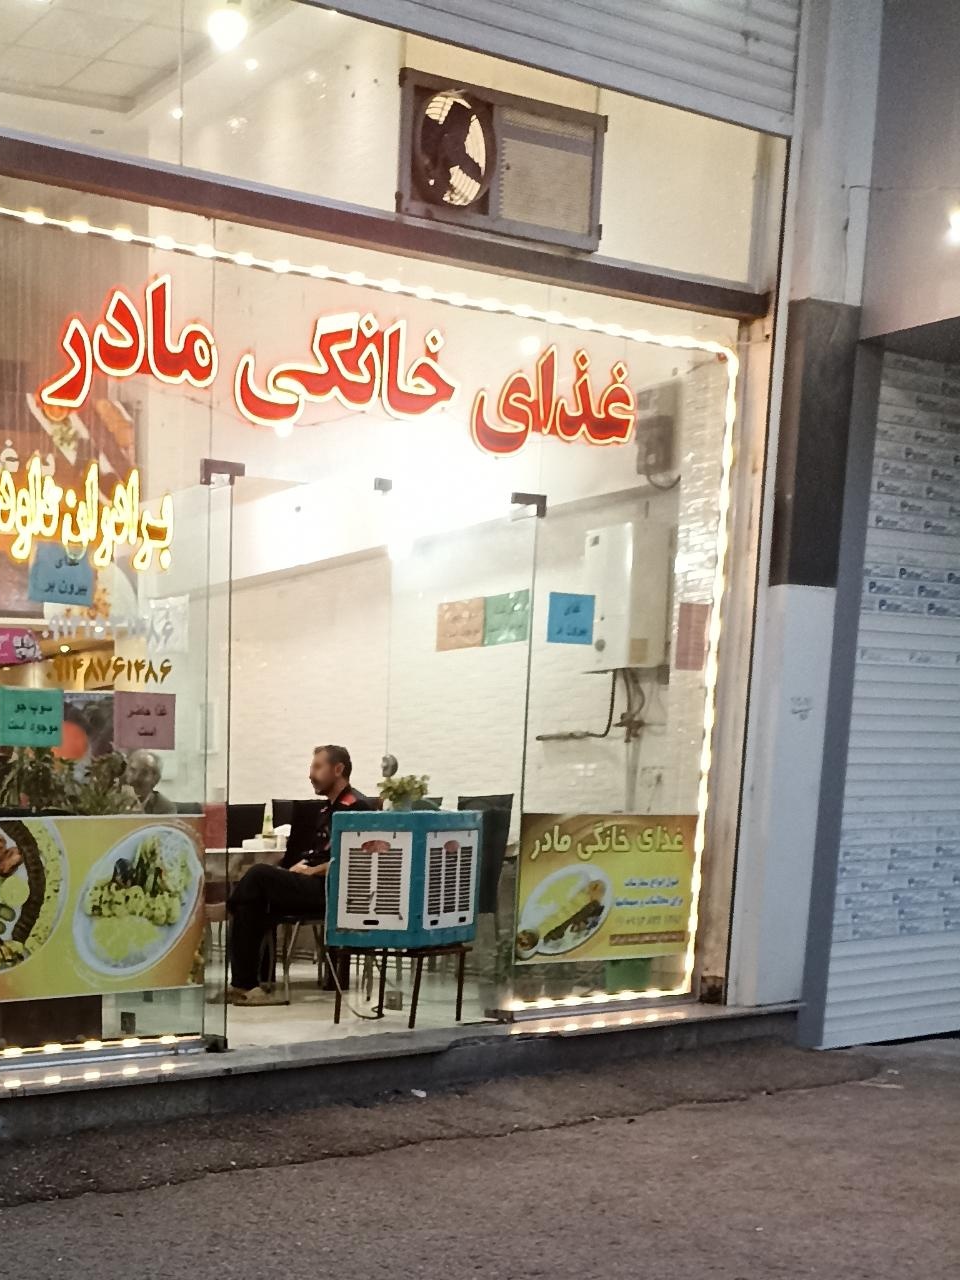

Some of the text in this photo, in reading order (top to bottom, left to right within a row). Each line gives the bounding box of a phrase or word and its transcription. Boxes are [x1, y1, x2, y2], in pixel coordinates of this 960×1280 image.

[41, 275, 219, 405] مادر
[471, 346, 637, 459] غذای
[529, 821, 685, 861] غذای خانگی مادر
